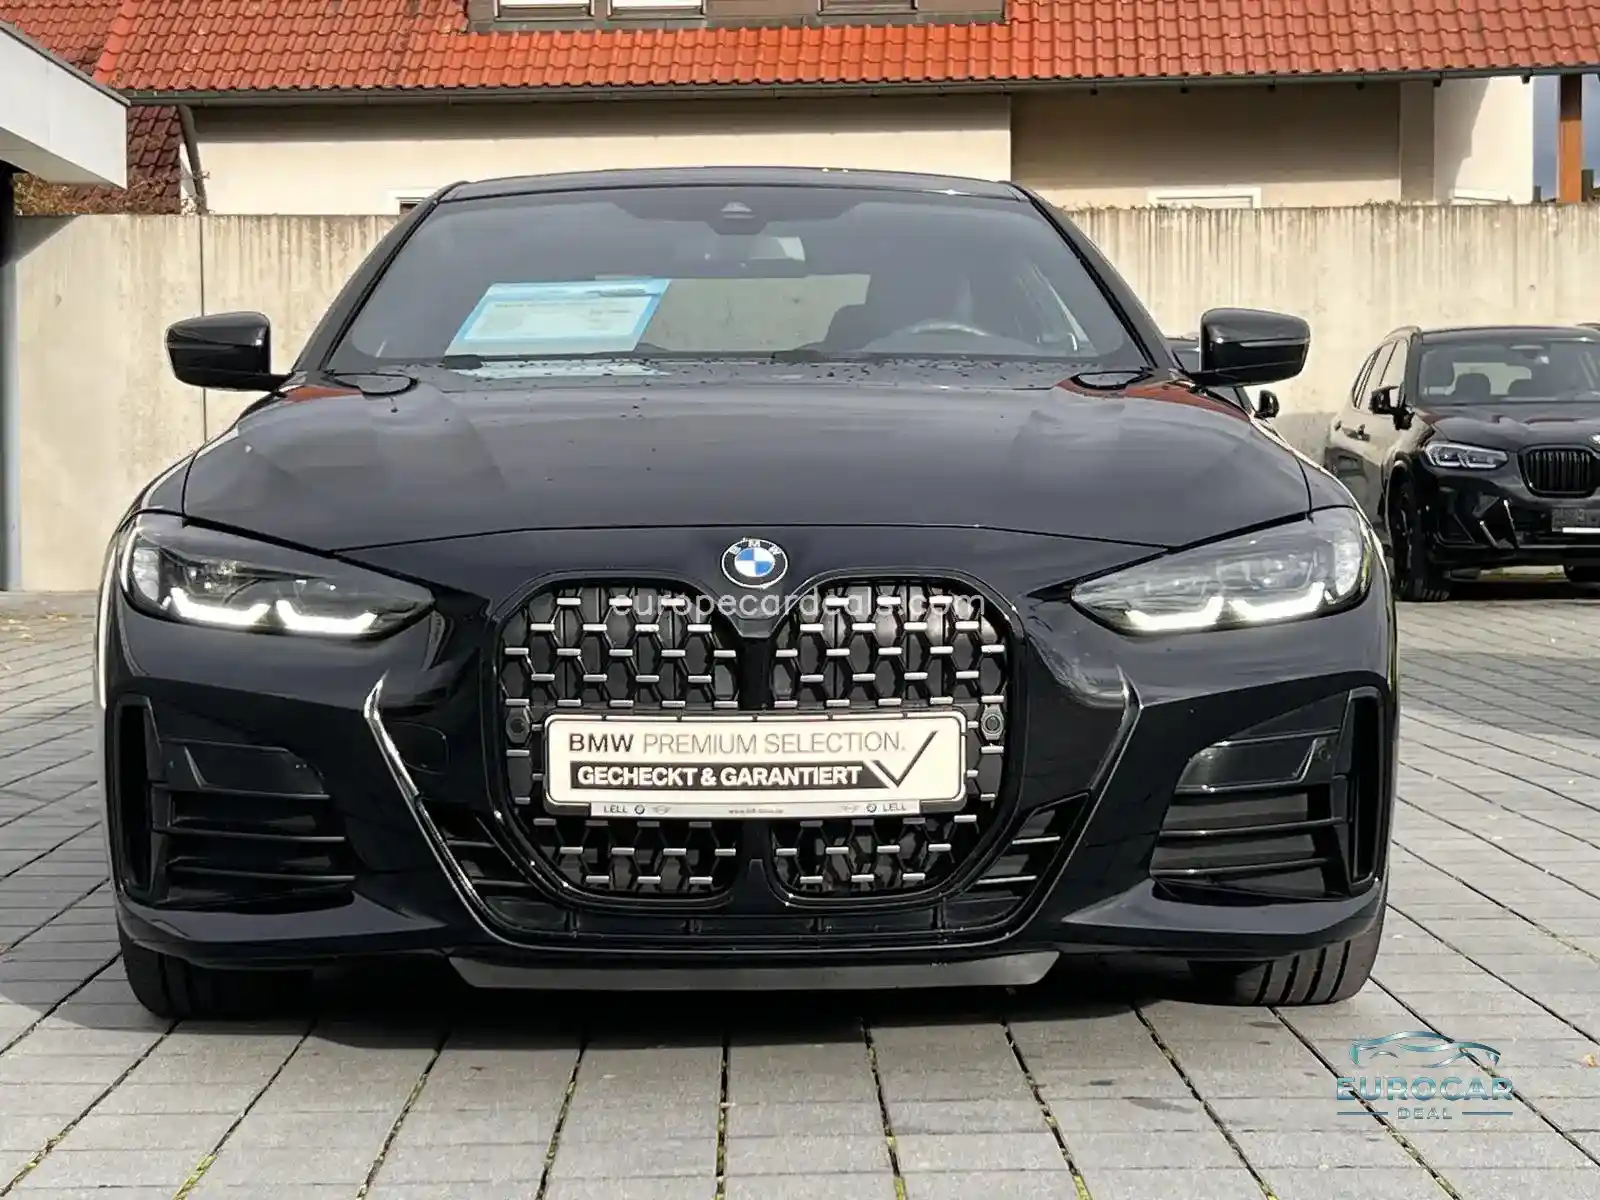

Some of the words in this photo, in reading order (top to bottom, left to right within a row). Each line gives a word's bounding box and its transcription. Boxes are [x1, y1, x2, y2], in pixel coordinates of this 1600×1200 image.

[569, 733, 634, 753] BMW
[643, 733, 757, 754] PREMIUM
[577, 765, 698, 786] GECHECKT
[700, 767, 717, 786] &
[720, 765, 862, 786] GARANTIERT
[604, 804, 627, 814] LELL
